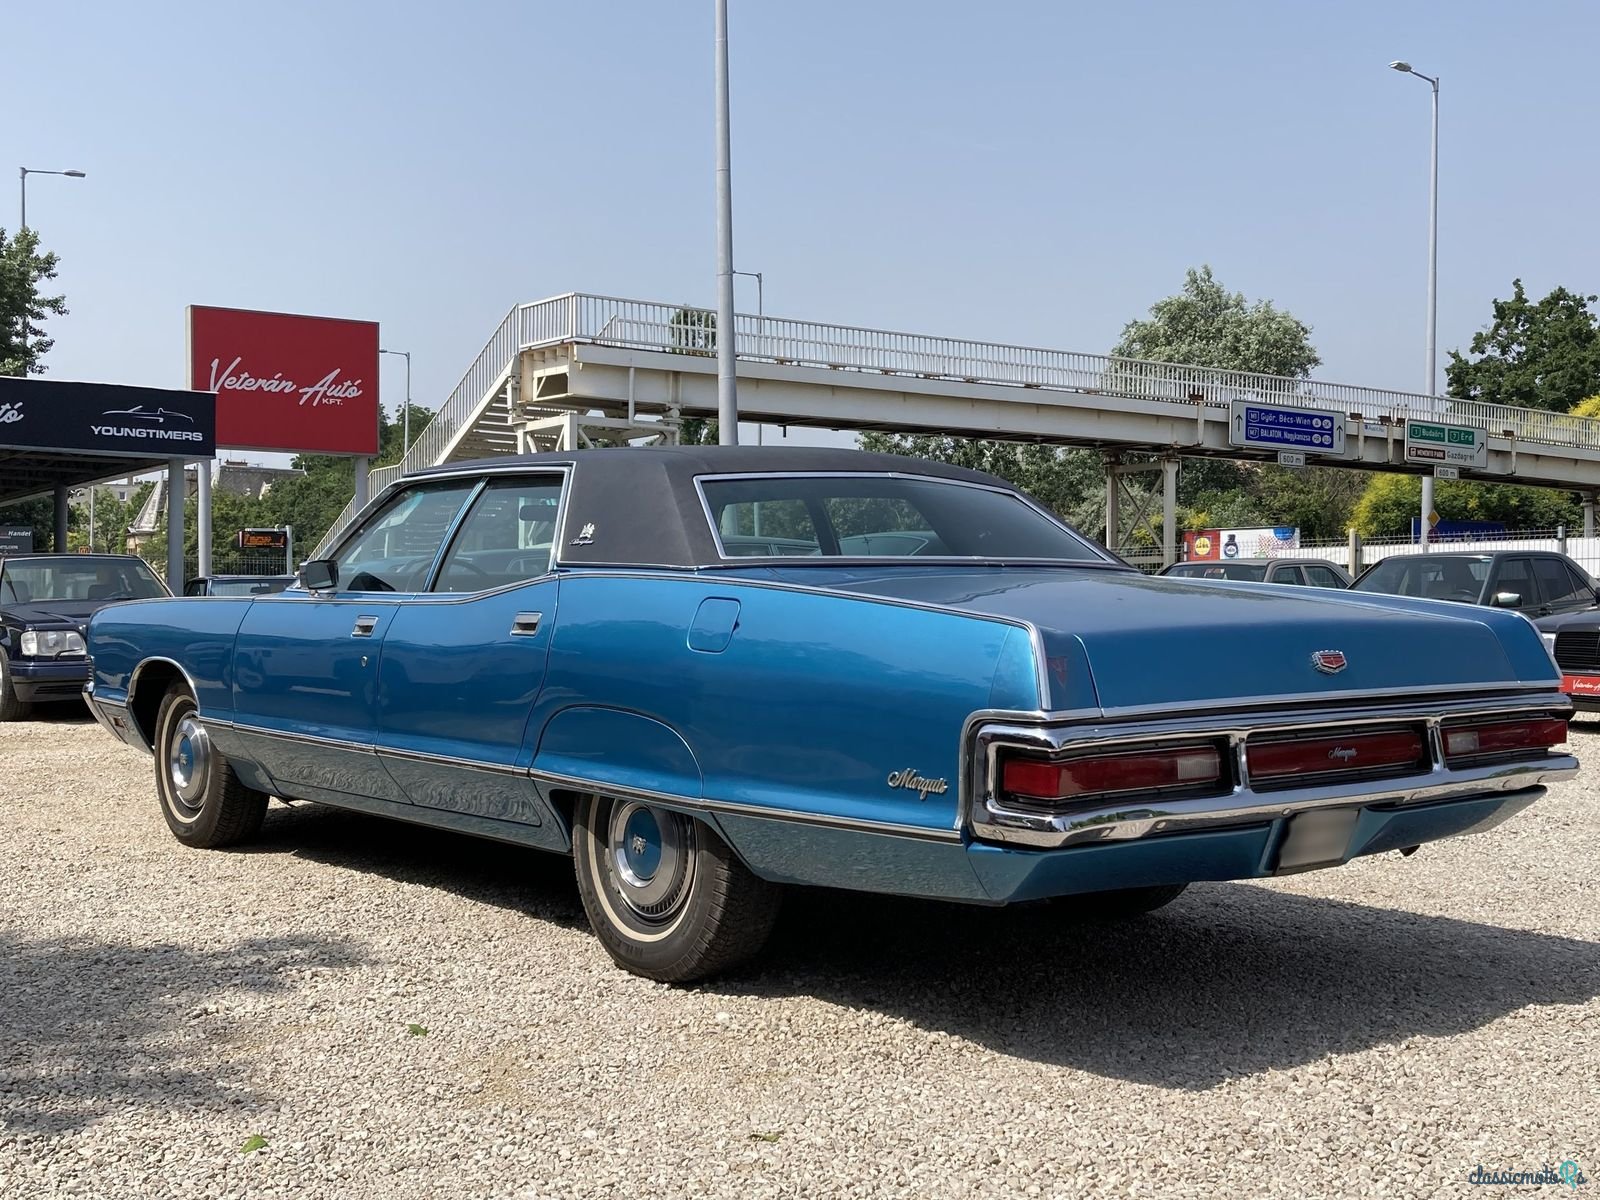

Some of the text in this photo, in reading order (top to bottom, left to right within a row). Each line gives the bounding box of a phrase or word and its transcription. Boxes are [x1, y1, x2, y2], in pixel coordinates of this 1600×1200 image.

[210, 356, 363, 407] Veterán Autó
[322, 397, 343, 406] KFT.
[90, 425, 203, 441] YOUNGTIMERS
[887, 767, 948, 800] Marquis
